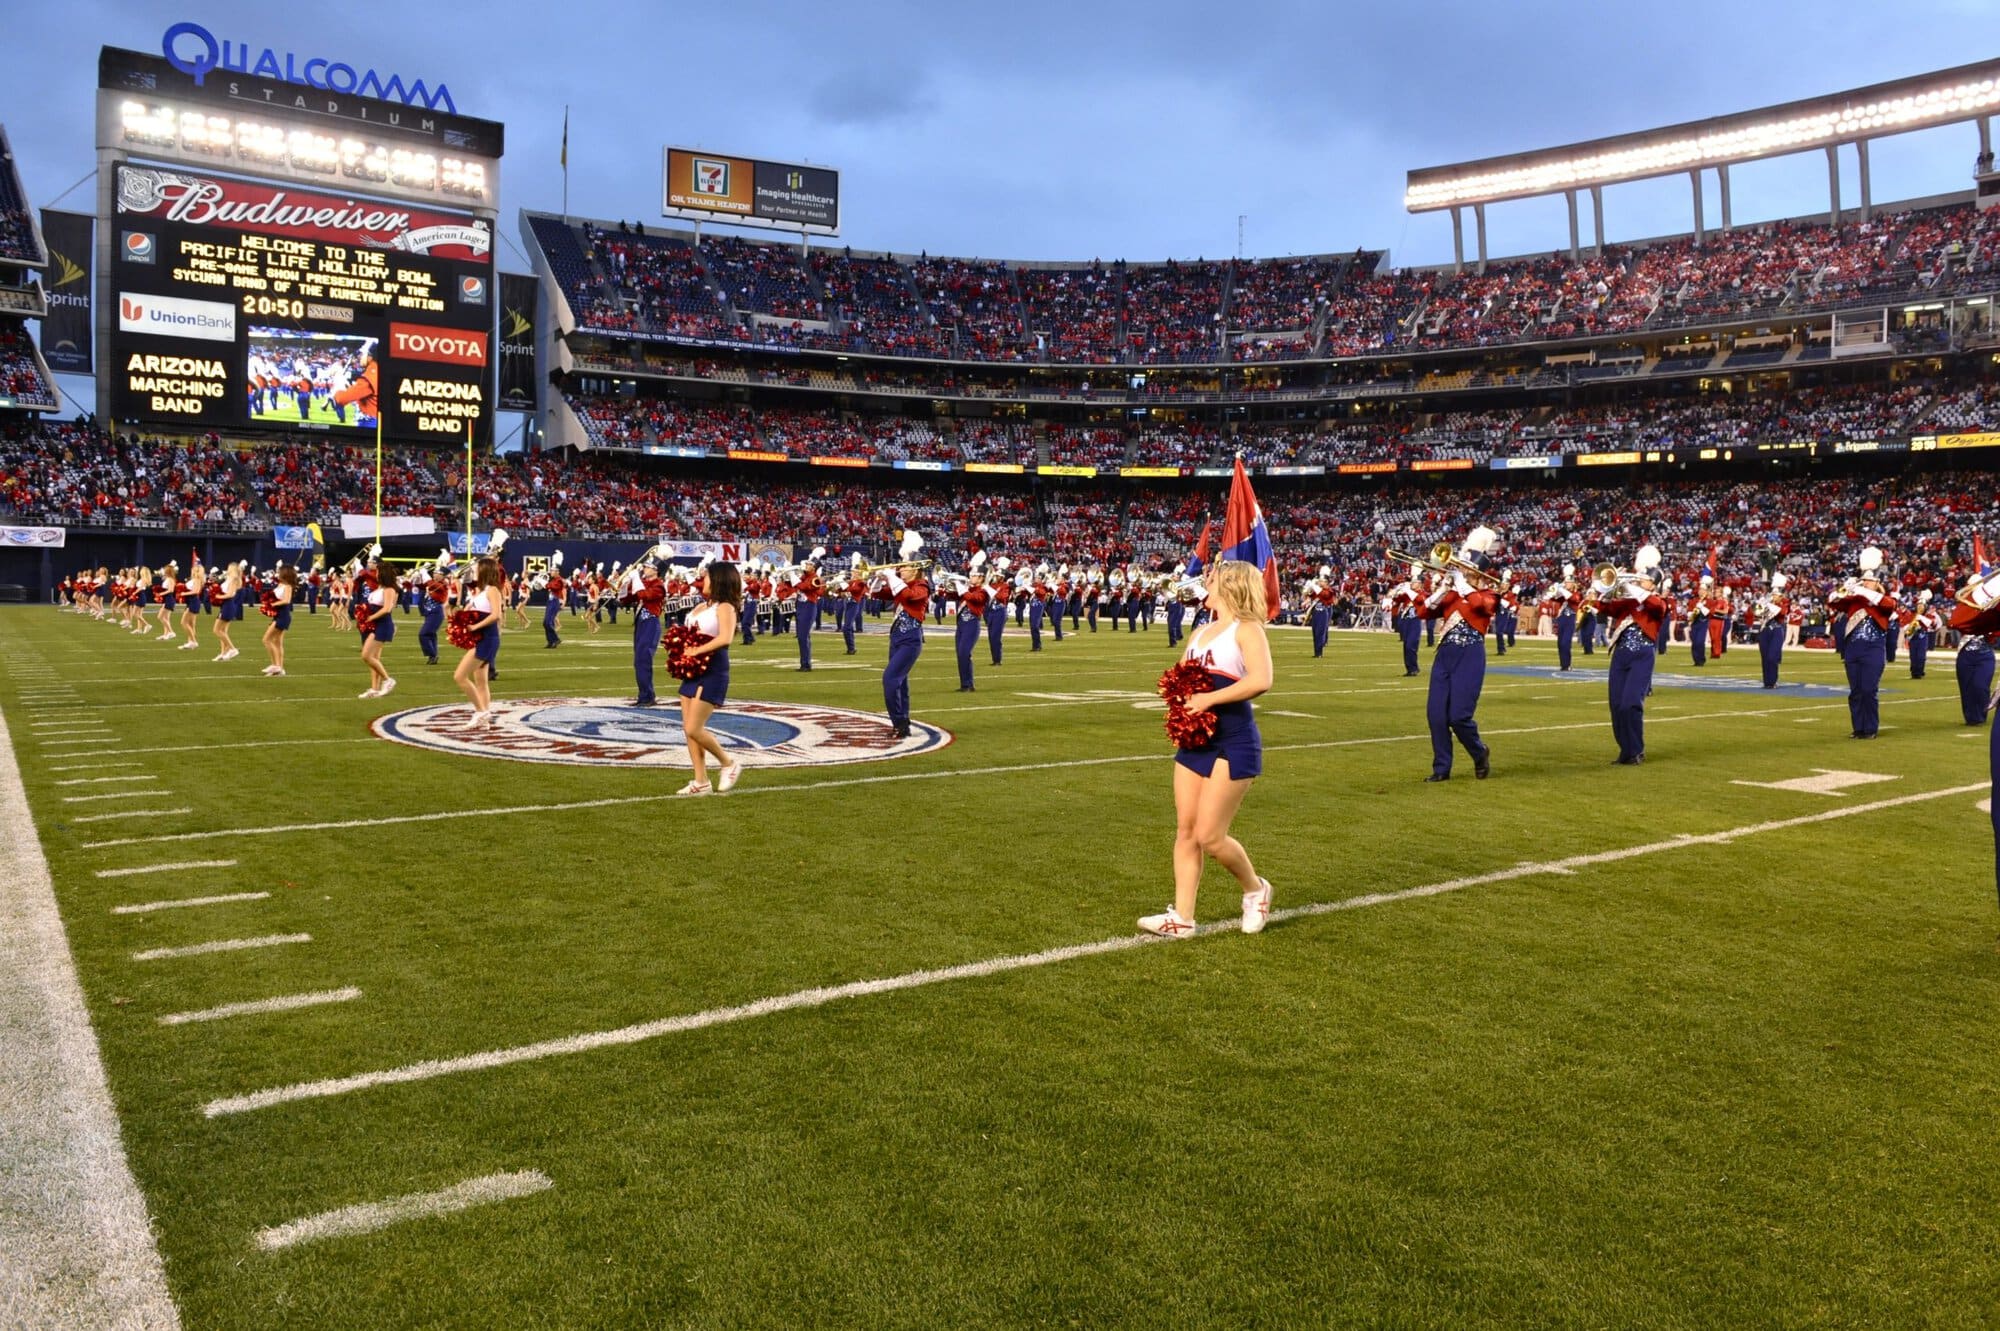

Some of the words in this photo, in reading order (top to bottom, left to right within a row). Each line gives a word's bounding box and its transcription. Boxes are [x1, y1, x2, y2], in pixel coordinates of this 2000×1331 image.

[162, 22, 457, 115] QUALCOMM
[229, 83, 434, 131] STADIUM
[687, 196, 716, 207] THANK
[757, 187, 789, 200] Imaging
[791, 192, 834, 205] Healthcare
[154, 183, 410, 232] Budweiser
[412, 231, 457, 247] American
[460, 231, 488, 245] Lager
[241, 235, 316, 256] WELCOME
[325, 246, 346, 260] TO
[355, 250, 385, 266] THE
[180, 241, 258, 263] PACIFIC
[267, 252, 310, 270] LIFE
[319, 259, 390, 279] HOLIDAY
[397, 269, 437, 286] BOWL
[190, 258, 259, 276] PRE-GAME
[266, 267, 300, 281] SHOW
[306, 273, 377, 290] PRESENTED
[383, 282, 400, 293] BY
[406, 285, 430, 297] THE
[44, 290, 89, 308] Sprint
[173, 268, 226, 285] SYCUAN
[233, 275, 267, 290] BAND
[274, 280, 291, 293] OF
[299, 283, 323, 297] THE
[398, 295, 444, 311] NATION
[243, 295, 304, 319] 20:50
[150, 309, 232, 329] UnionBank
[394, 332, 483, 359] TOYOTA
[499, 341, 535, 357] Sprint
[128, 353, 226, 379] ARIZONA
[129, 377, 224, 398] MARCHING
[398, 378, 482, 401] ARIZONA
[151, 396, 203, 415] BAND
[400, 398, 480, 418] MARCHING
[418, 416, 462, 433] BAND
[1340, 464, 1367, 473] WELLS
[722, 544, 740, 560] N
[527, 556, 548, 572] 25
